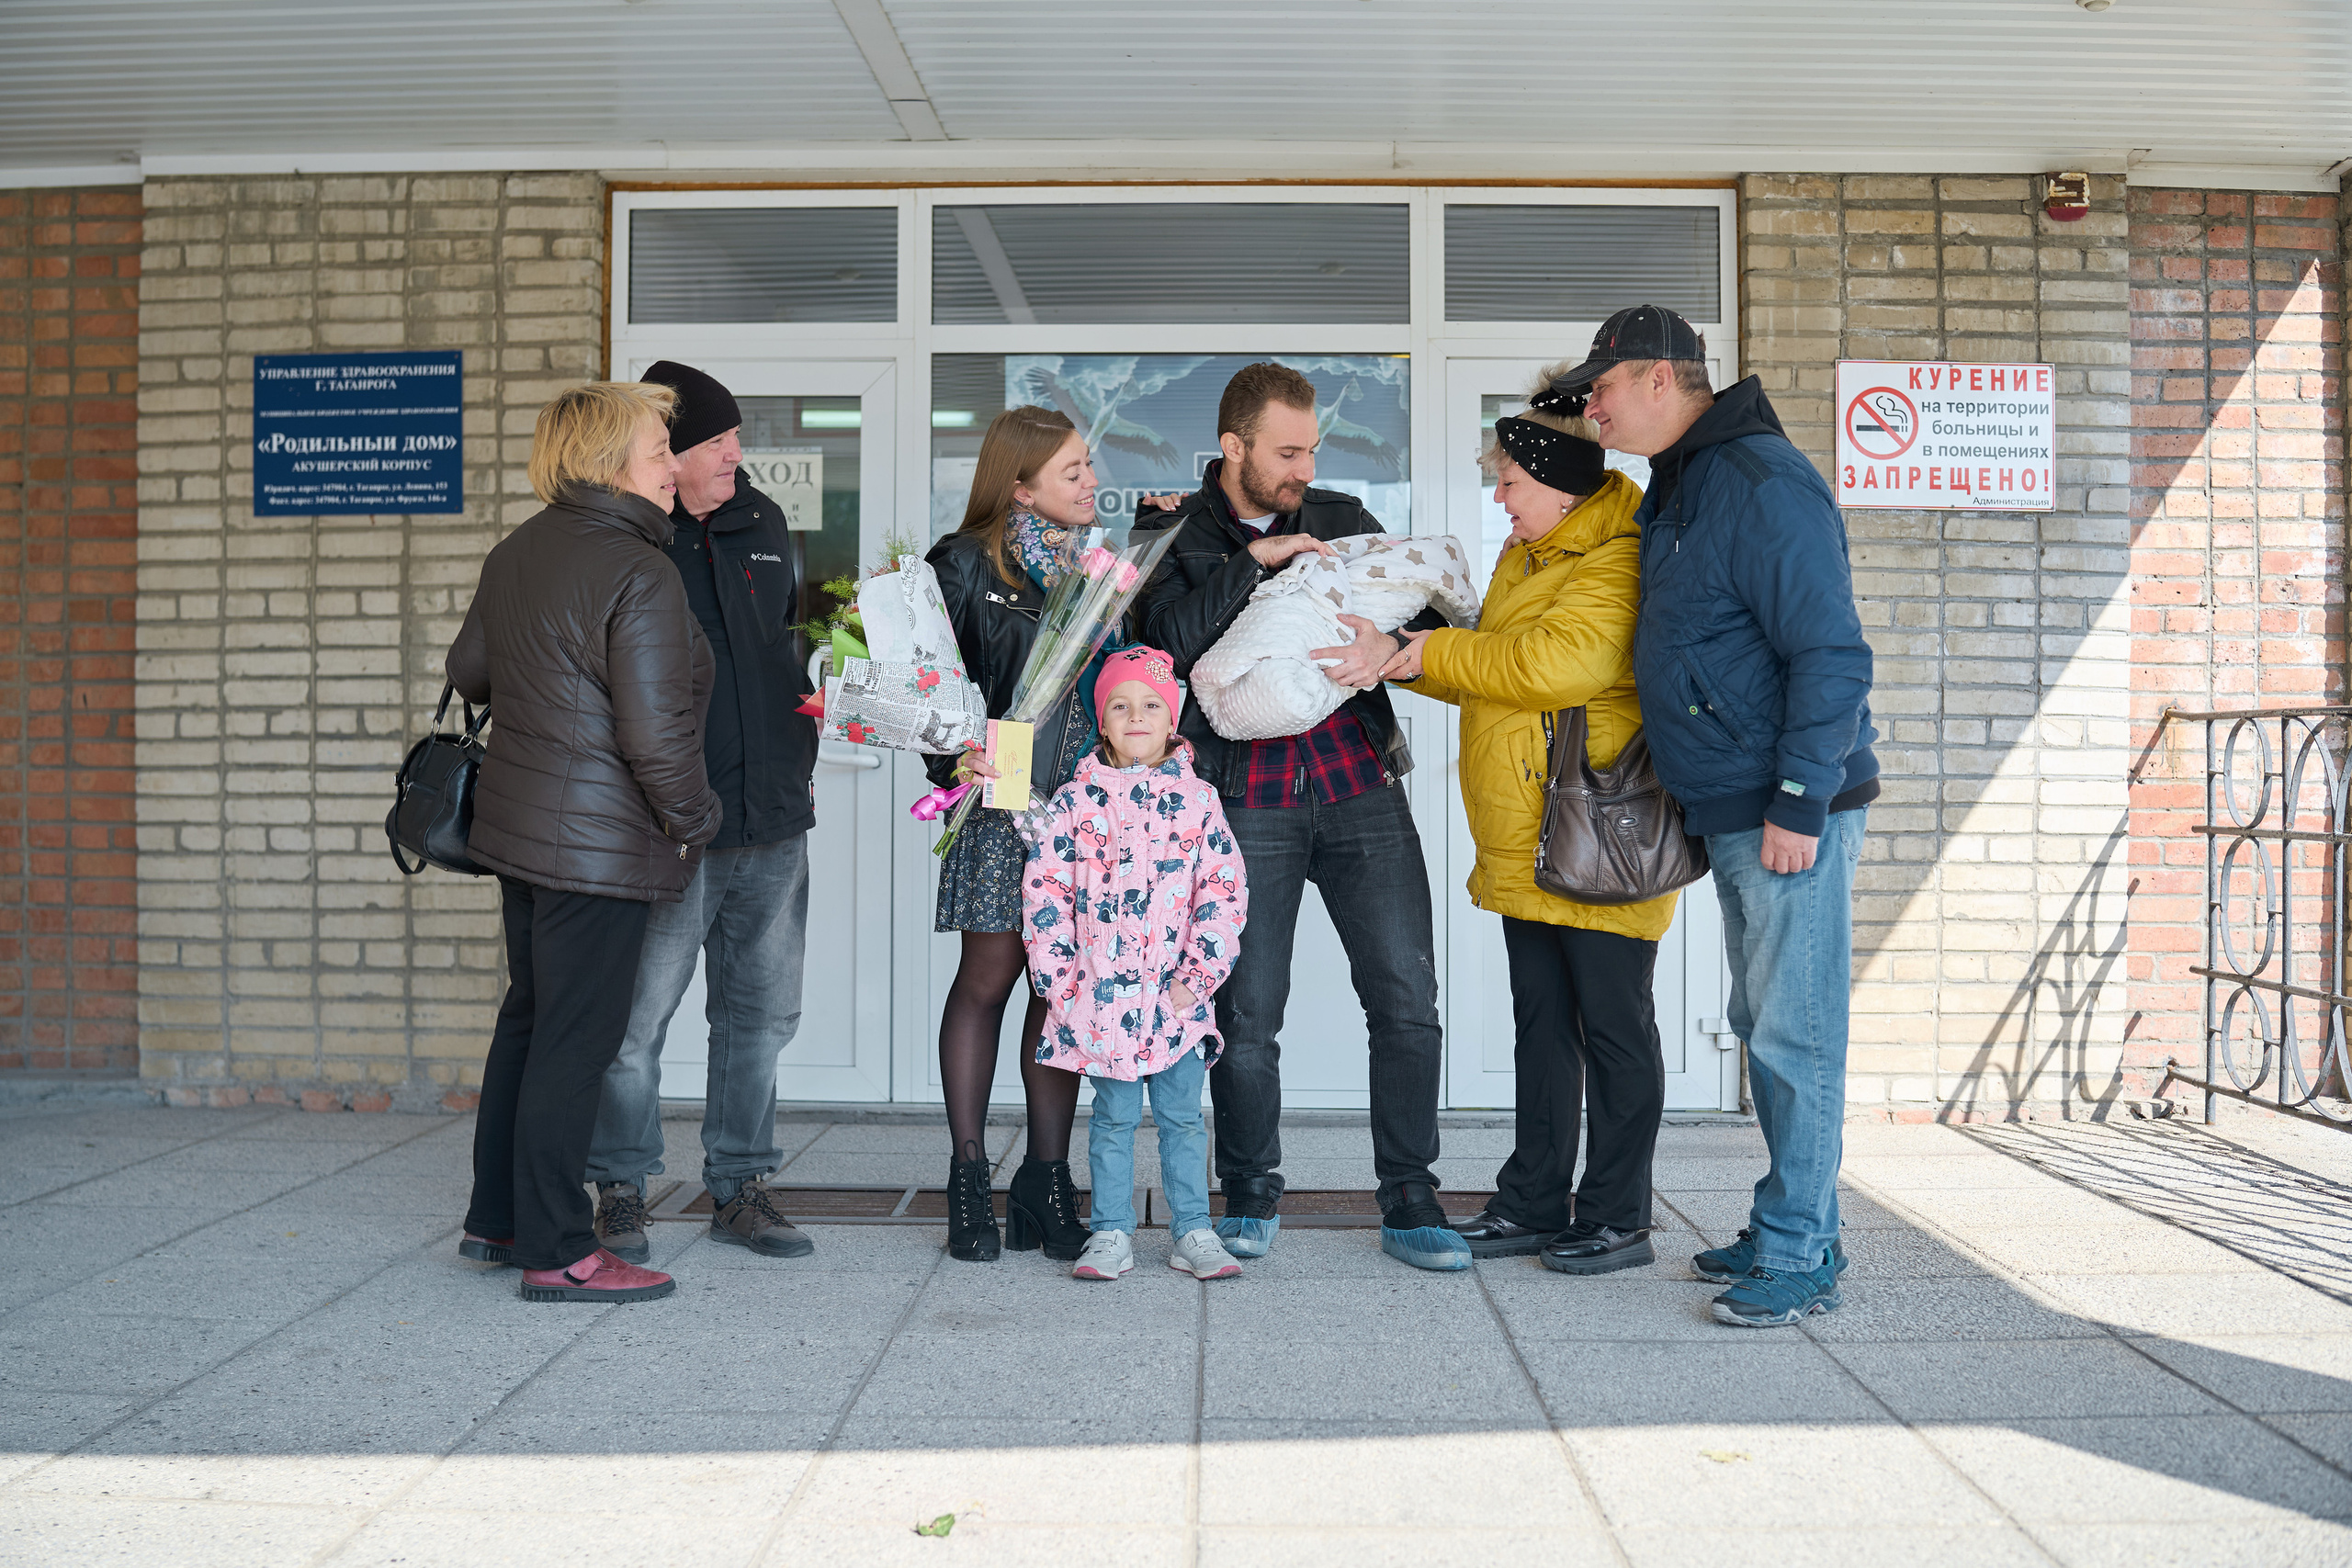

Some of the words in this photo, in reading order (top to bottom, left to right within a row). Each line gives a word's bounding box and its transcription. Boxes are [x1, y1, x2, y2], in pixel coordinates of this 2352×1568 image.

[259, 367, 338, 379] УПРАВЛЕНИЕ
[340, 365, 456, 378] ЗДРАВООХРАНЕНИЯ
[1909, 367, 2049, 392] КУРЕНИЕ
[315, 380, 326, 391] Г.
[330, 379, 397, 390] ТАГАНРОГА
[1921, 400, 1940, 412] на
[1947, 402, 2049, 417] территории
[1932, 420, 2023, 437] больницы
[2030, 425, 2039, 435] и
[402, 435, 457, 453] дом»
[1923, 446, 1932, 456] в
[1939, 446, 2049, 459] помещениях
[292, 457, 379, 472] АКУШЕРСКИЙ
[381, 459, 432, 470] КОРПУС
[740, 462, 813, 489] ХОД
[1844, 465, 2049, 495] ЗАПРЕЩЕНО!
[1973, 497, 2049, 506] Администрация
[757, 553, 781, 562] Columbia
